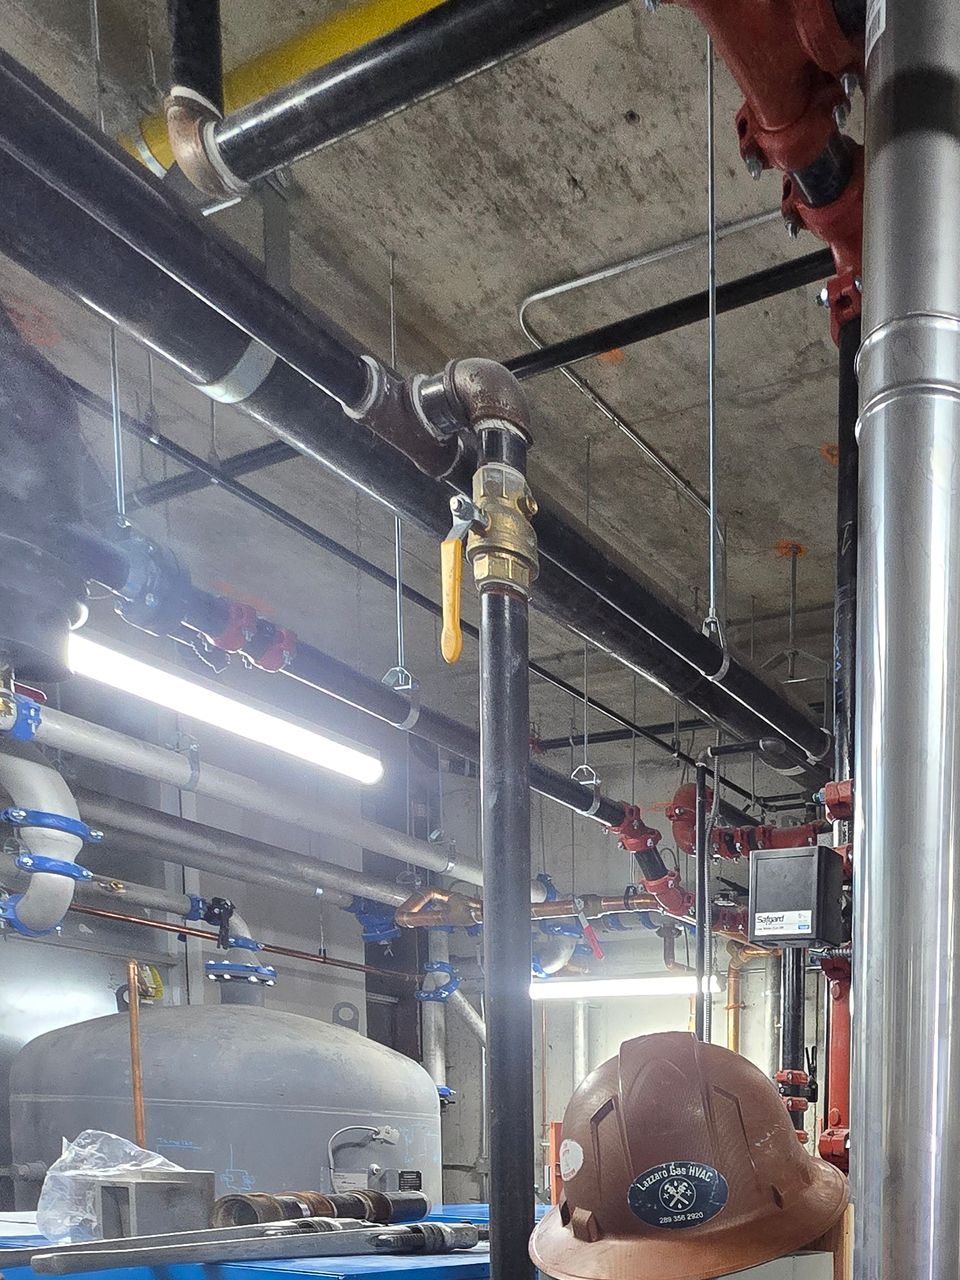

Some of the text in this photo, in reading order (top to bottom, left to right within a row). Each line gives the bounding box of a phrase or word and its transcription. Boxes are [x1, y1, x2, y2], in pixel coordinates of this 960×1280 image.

[757, 915, 784, 925] Safgard
[636, 1164, 713, 1191] Lazzaro Gas HVAC
[659, 1211, 704, 1224] 289 356 2920
